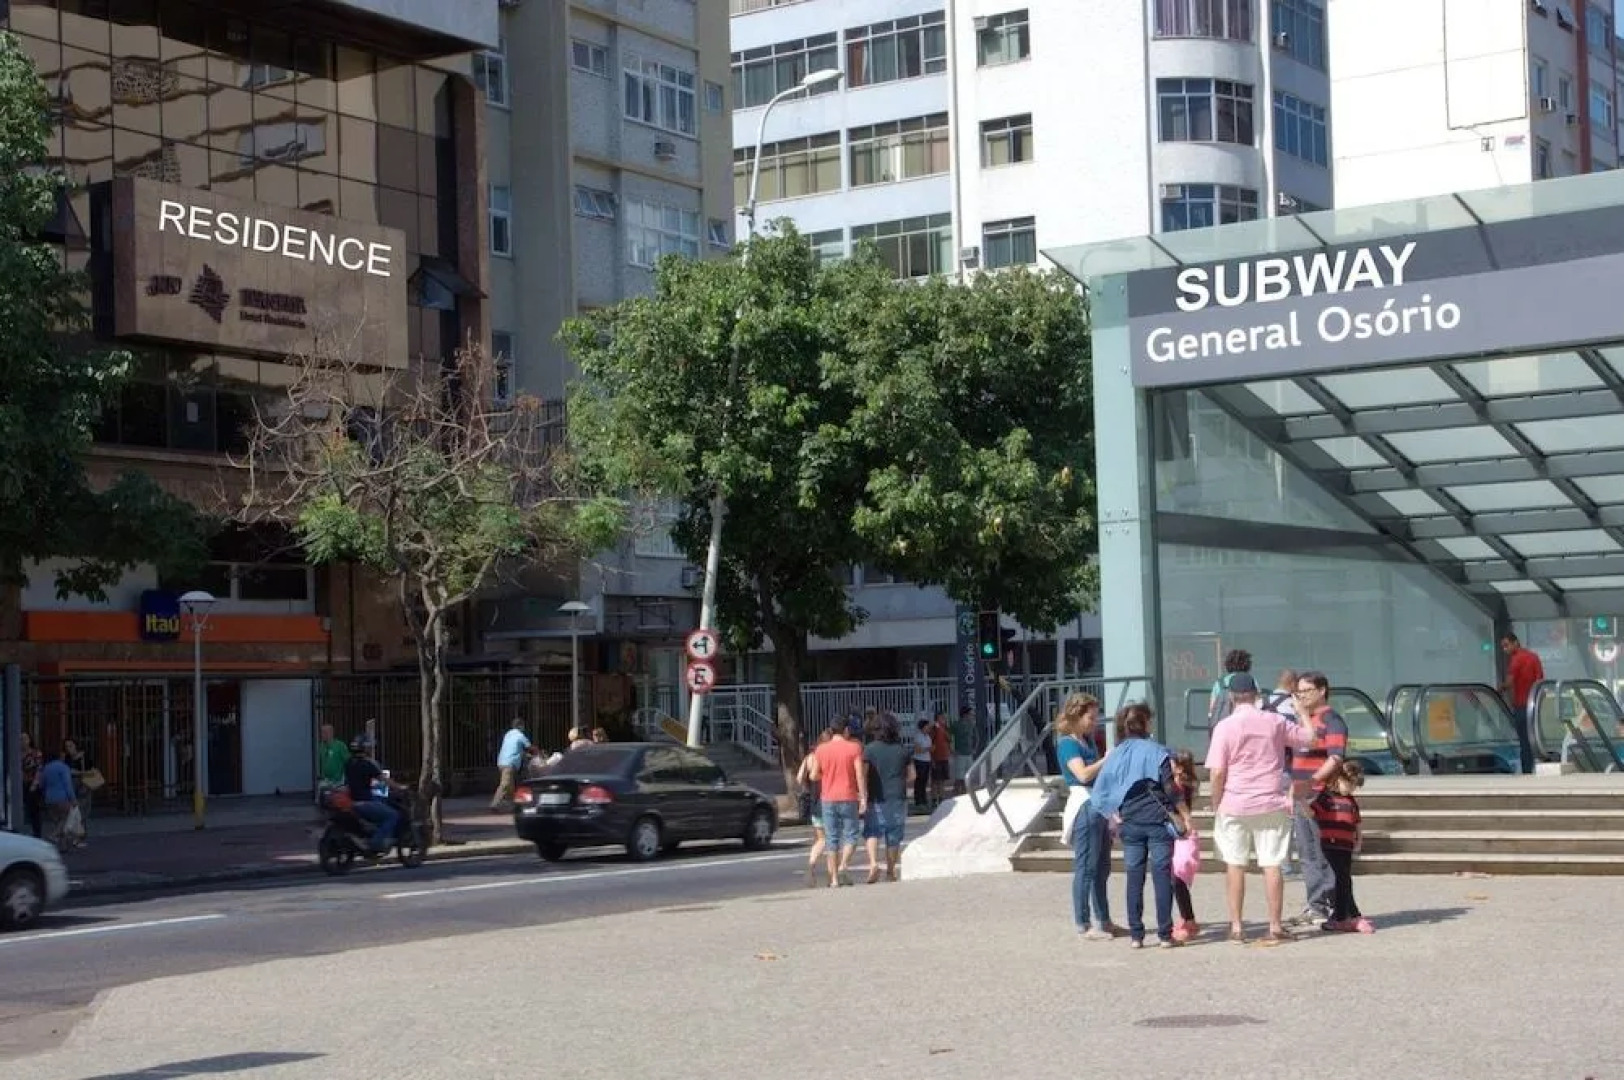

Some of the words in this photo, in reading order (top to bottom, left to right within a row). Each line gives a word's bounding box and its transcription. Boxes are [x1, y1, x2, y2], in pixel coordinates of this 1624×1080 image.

[158, 200, 392, 277] RESIDENCE
[1175, 242, 1417, 312] SUBWAY
[1146, 310, 1302, 363] General
[1317, 293, 1461, 343] Osório
[145, 613, 180, 633] Itaú
